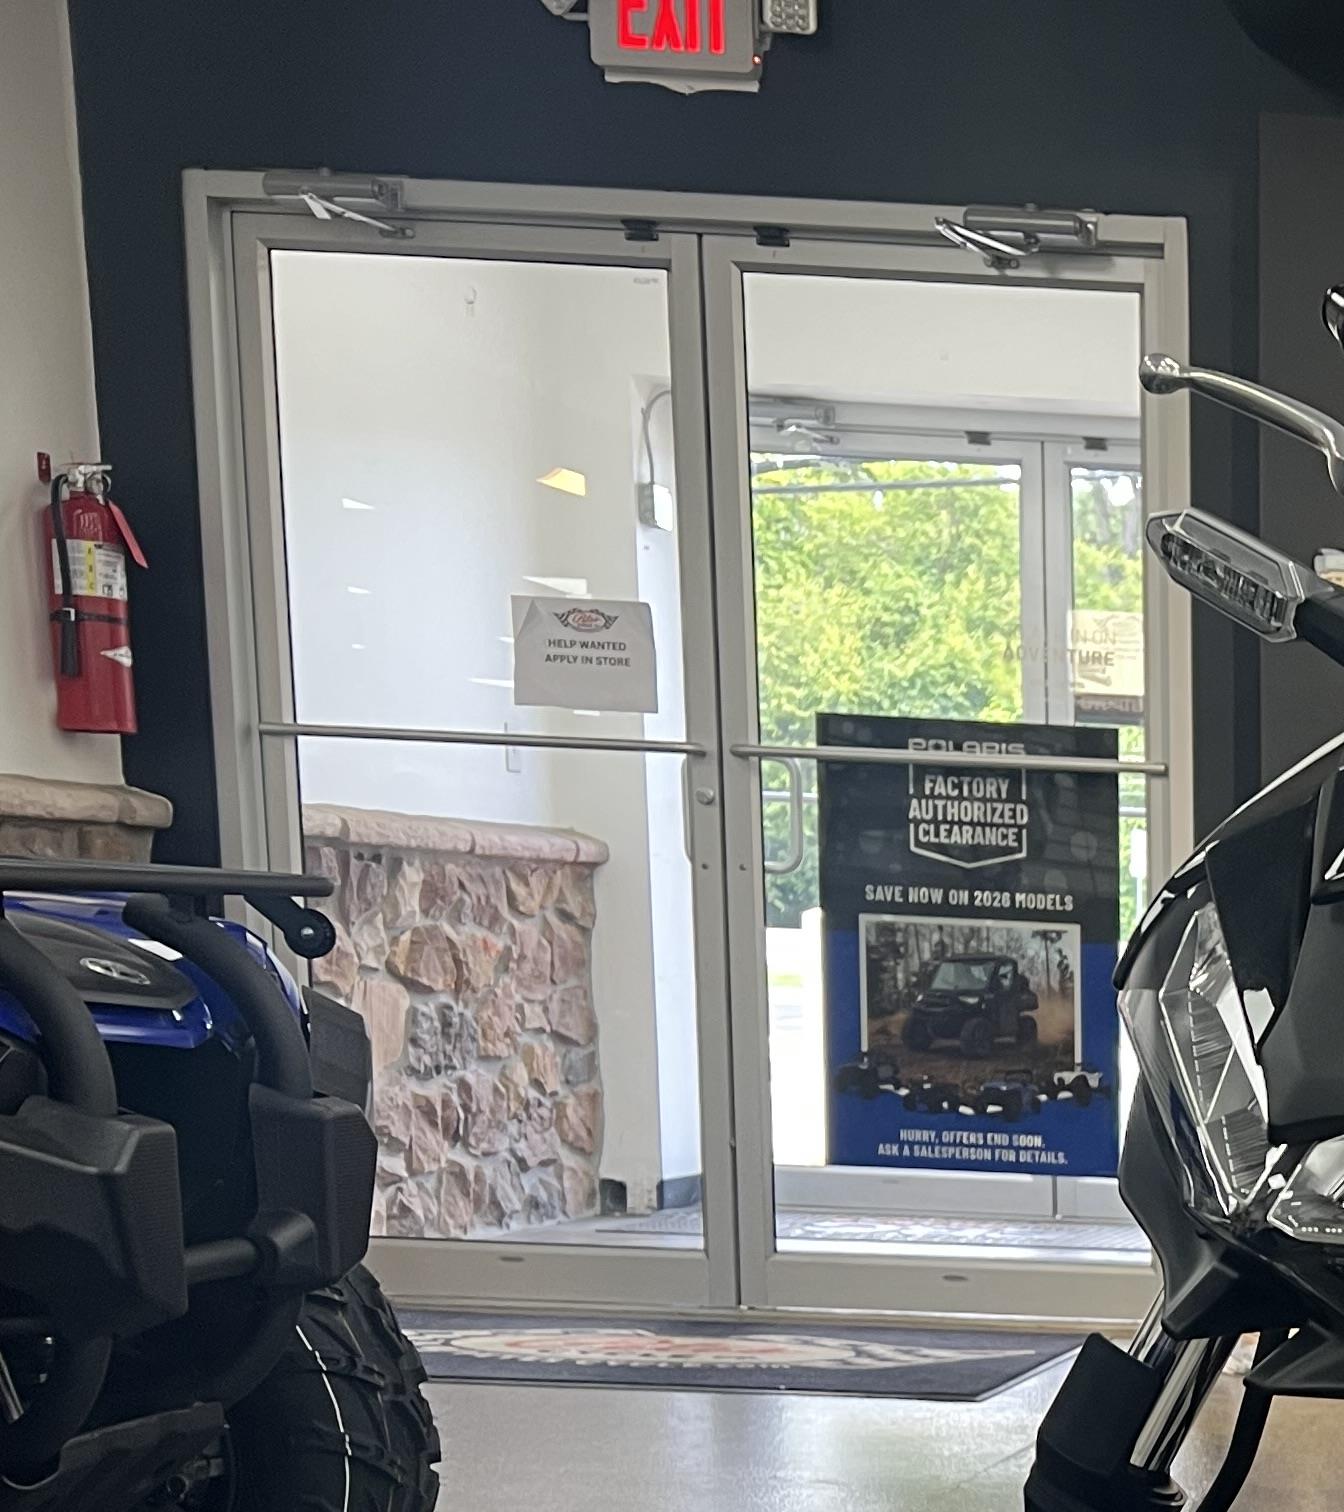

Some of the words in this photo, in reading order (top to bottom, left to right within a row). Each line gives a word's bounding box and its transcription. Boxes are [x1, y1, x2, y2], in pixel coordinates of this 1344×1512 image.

[547, 638, 577, 649] HELP
[579, 640, 627, 651] WANTED
[545, 653, 578, 665] APPLY
[580, 655, 593, 665] IN
[595, 656, 632, 668] STORE
[907, 737, 1026, 755] POLARIS
[924, 773, 1010, 800] FACTORY
[908, 797, 1029, 826] AUTHORIZED
[918, 822, 1019, 847] CLEARANCE
[864, 884, 904, 903] SAVE
[908, 886, 944, 905] NOW
[948, 888, 970, 906] ON
[1014, 891, 1074, 912] MODELS
[941, 1130, 984, 1146] OFFERS
[986, 1132, 1010, 1147] END
[877, 1143, 899, 1156] ASK
[902, 1144, 911, 1157] A
[913, 1144, 992, 1161] SALESPERSON
[995, 1148, 1015, 1162] FOR
